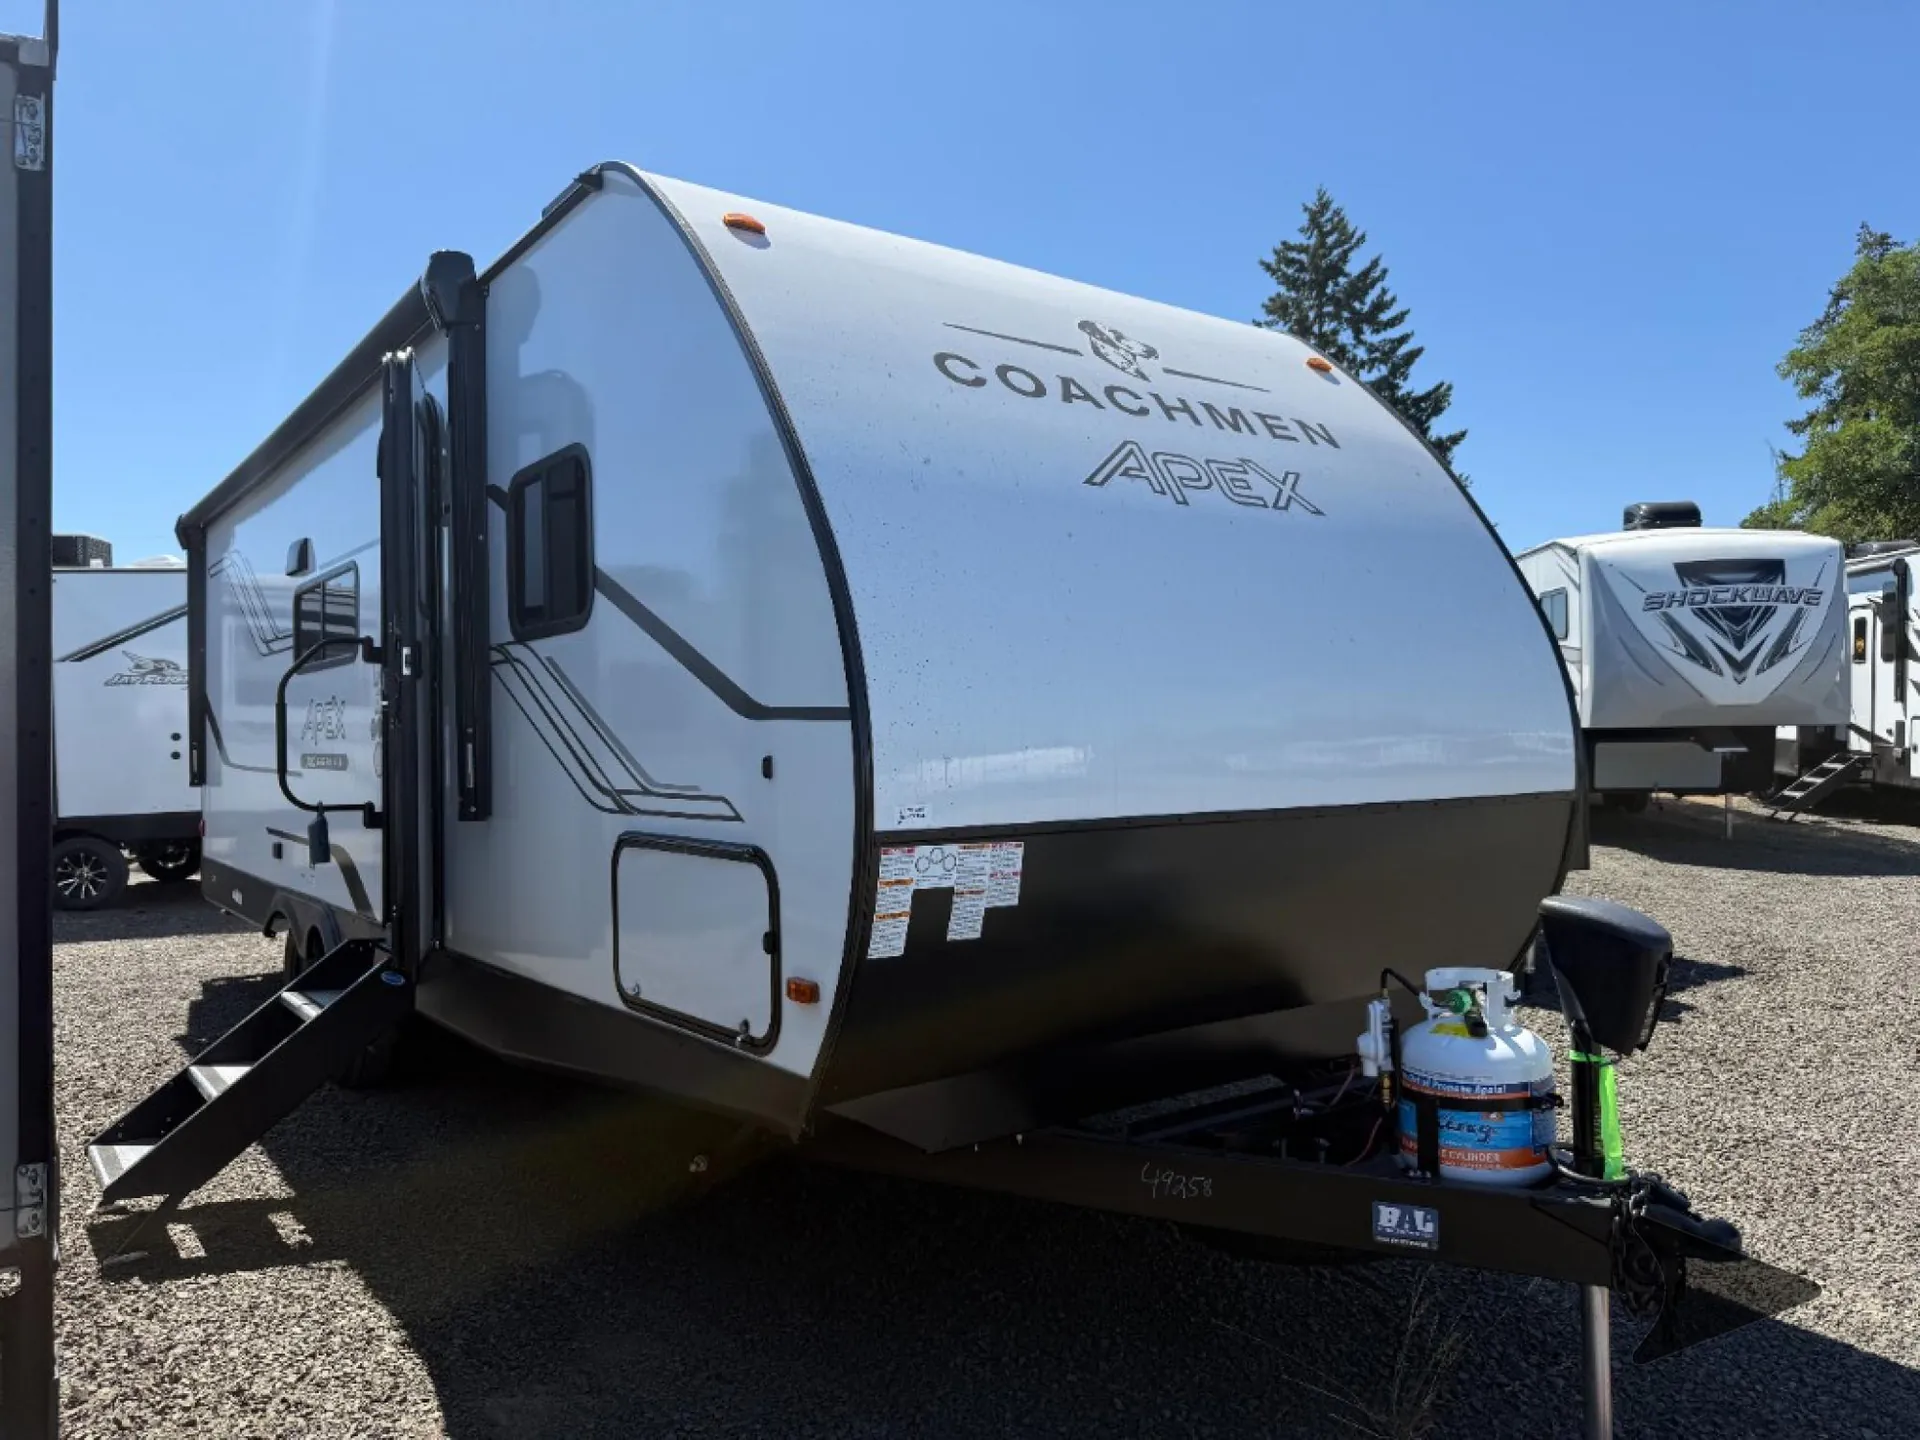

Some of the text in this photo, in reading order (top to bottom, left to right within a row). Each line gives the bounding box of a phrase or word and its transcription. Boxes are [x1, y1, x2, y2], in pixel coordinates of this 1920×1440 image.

[933, 351, 1342, 449] COACHMEN
[1083, 439, 1326, 516] APEX
[1642, 586, 1824, 612] SHOCKWAVE
[300, 694, 346, 746] APEX
